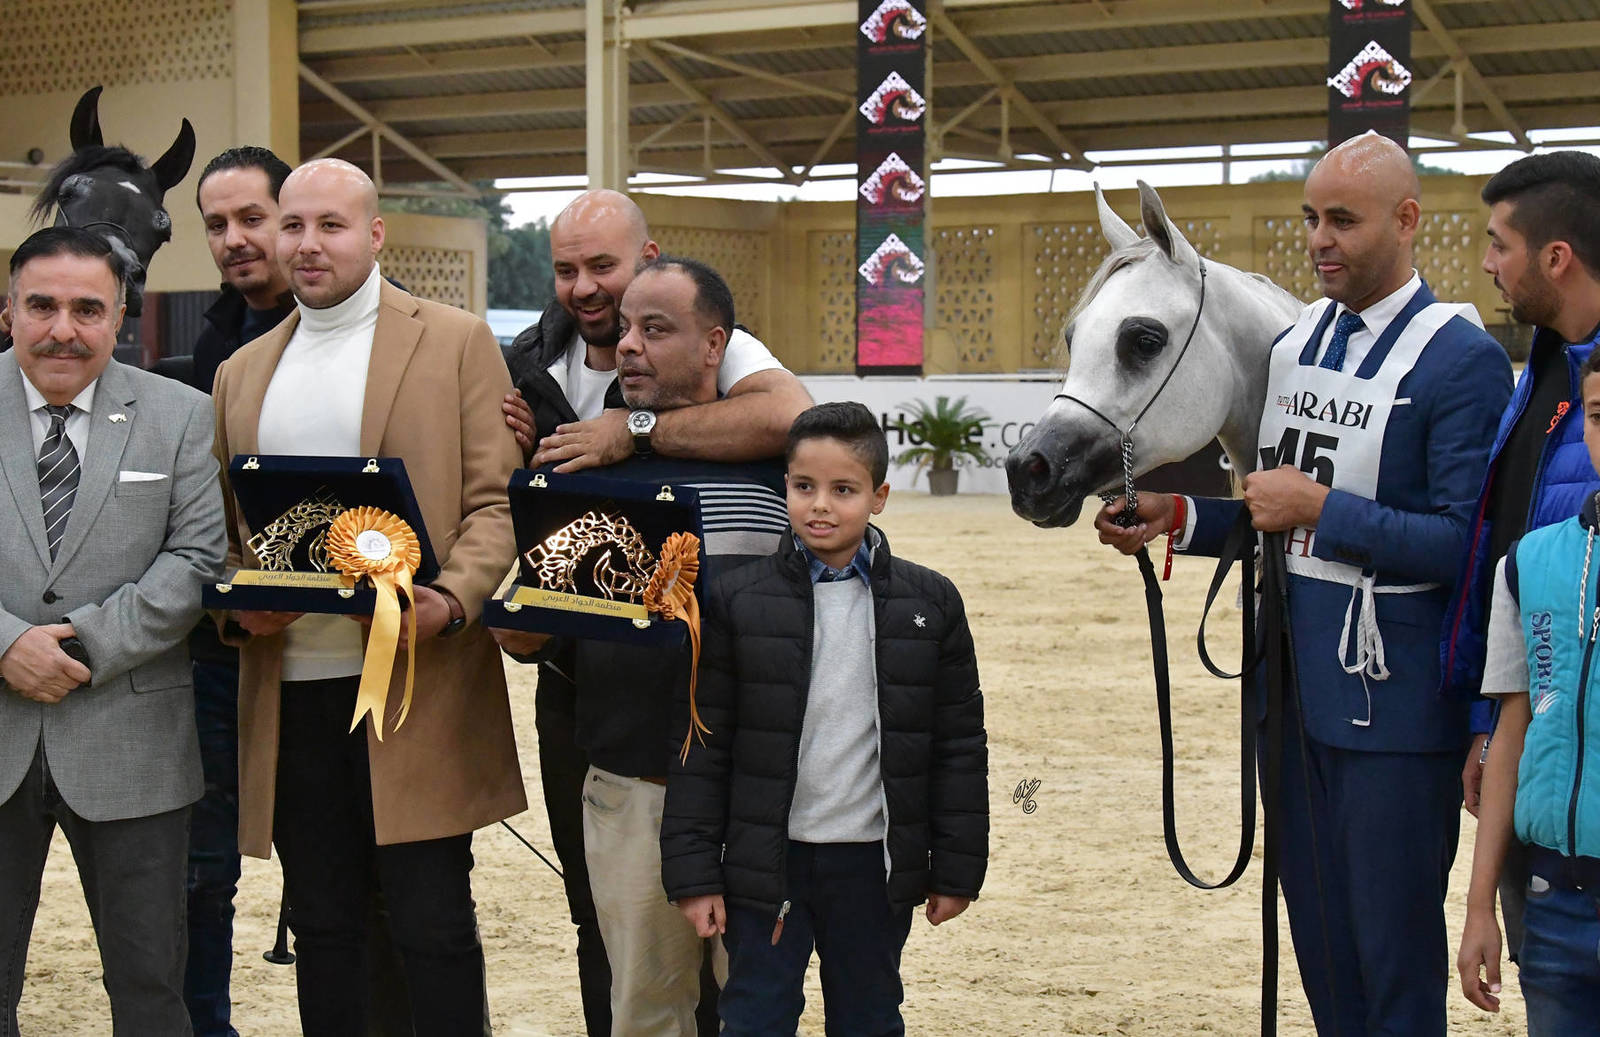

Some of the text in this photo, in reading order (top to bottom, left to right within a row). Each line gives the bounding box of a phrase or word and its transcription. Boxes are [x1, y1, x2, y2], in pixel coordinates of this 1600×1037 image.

[1285, 391, 1374, 430] ARABI
[543, 594, 569, 602] العربي
[572, 597, 594, 606] الجواد
[594, 601, 622, 611] منظمة
